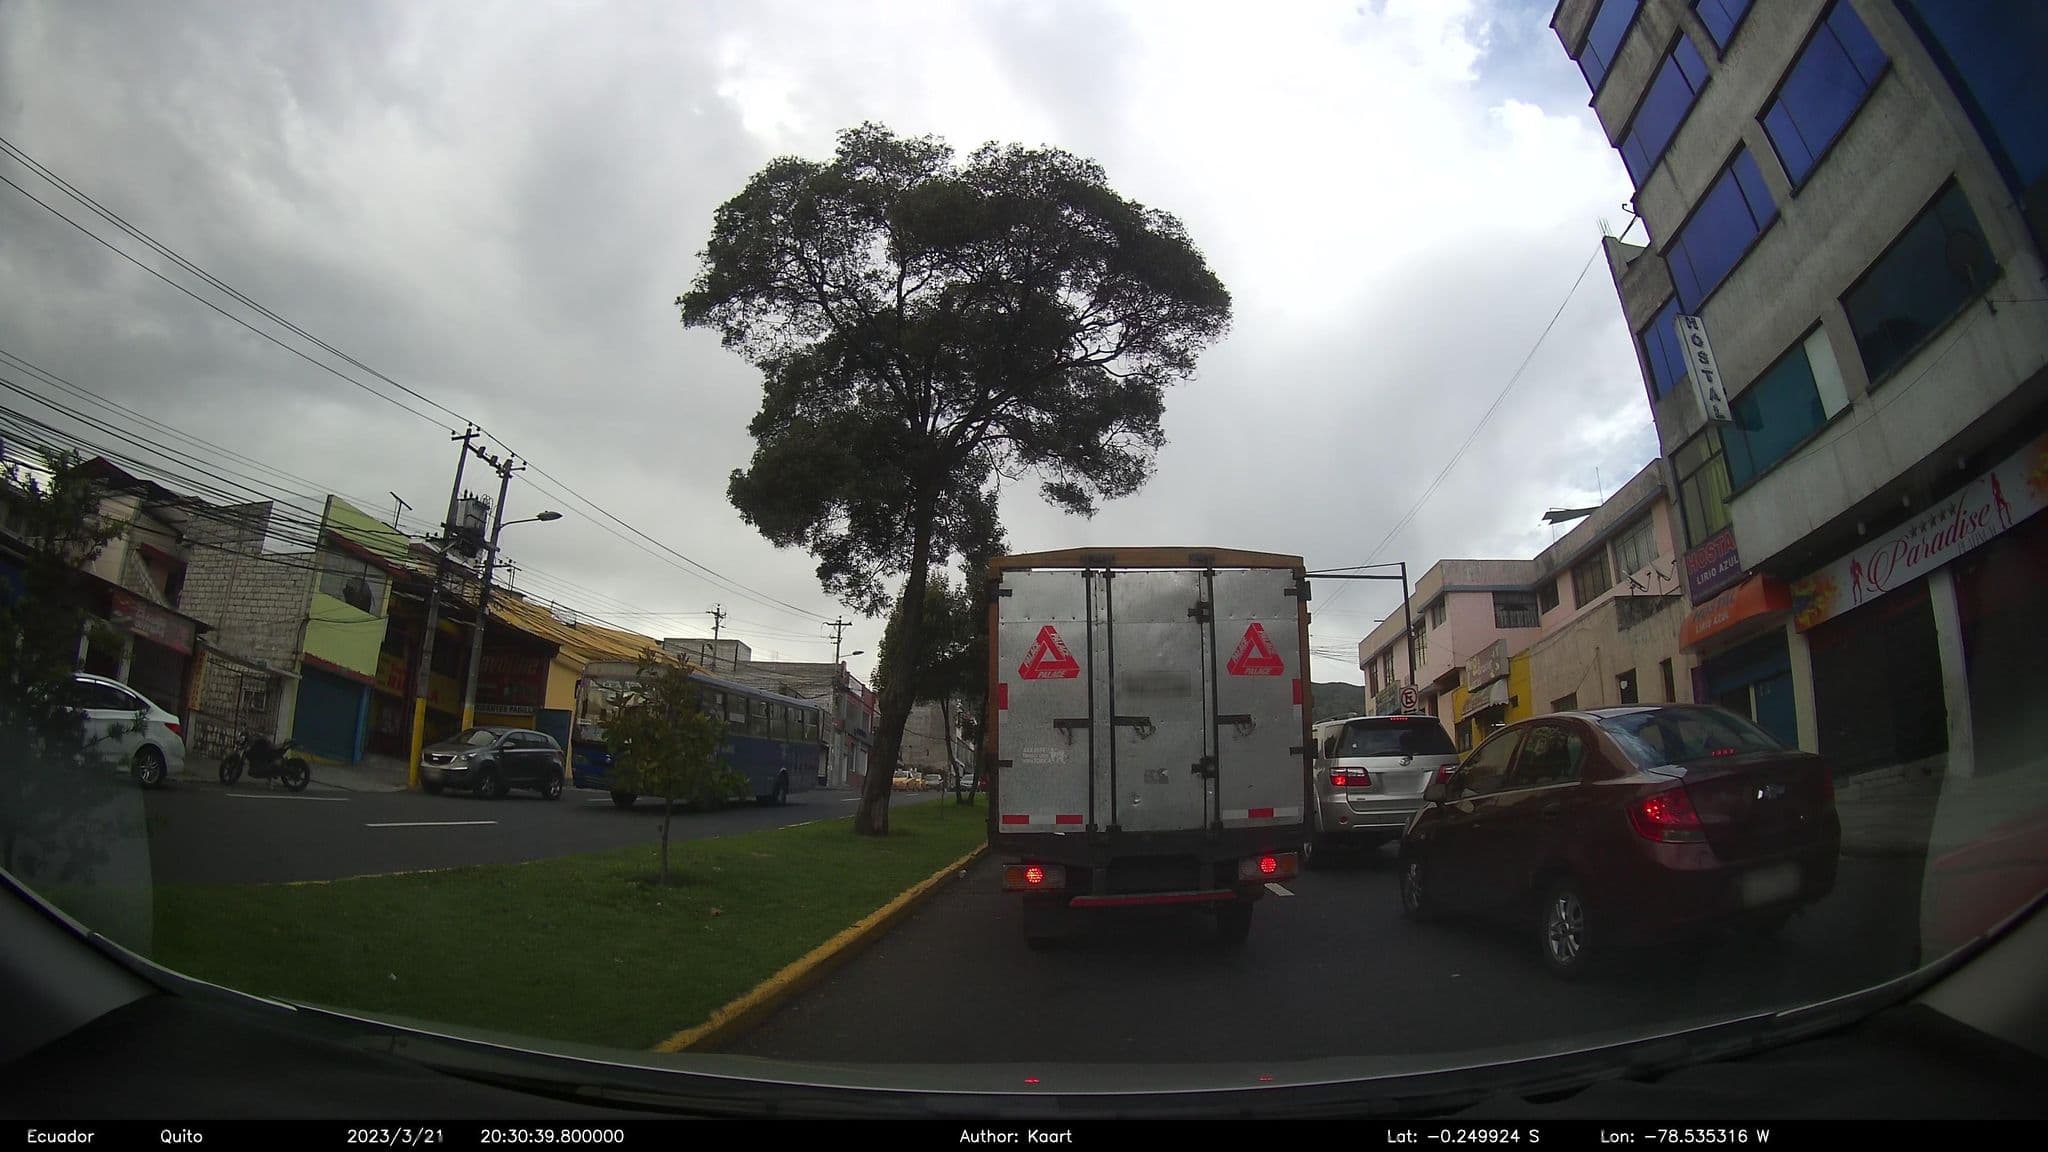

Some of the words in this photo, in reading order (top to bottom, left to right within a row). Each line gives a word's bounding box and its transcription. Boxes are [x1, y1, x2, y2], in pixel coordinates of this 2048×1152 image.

[1685, 316, 1726, 419] HOSTAL
[1867, 486, 1989, 593] Paradise
[1696, 567, 1717, 585] LIRIO
[1718, 555, 1740, 574] AZUL
[1037, 670, 1065, 679] PALACE
[1245, 667, 1271, 676] PALACE
